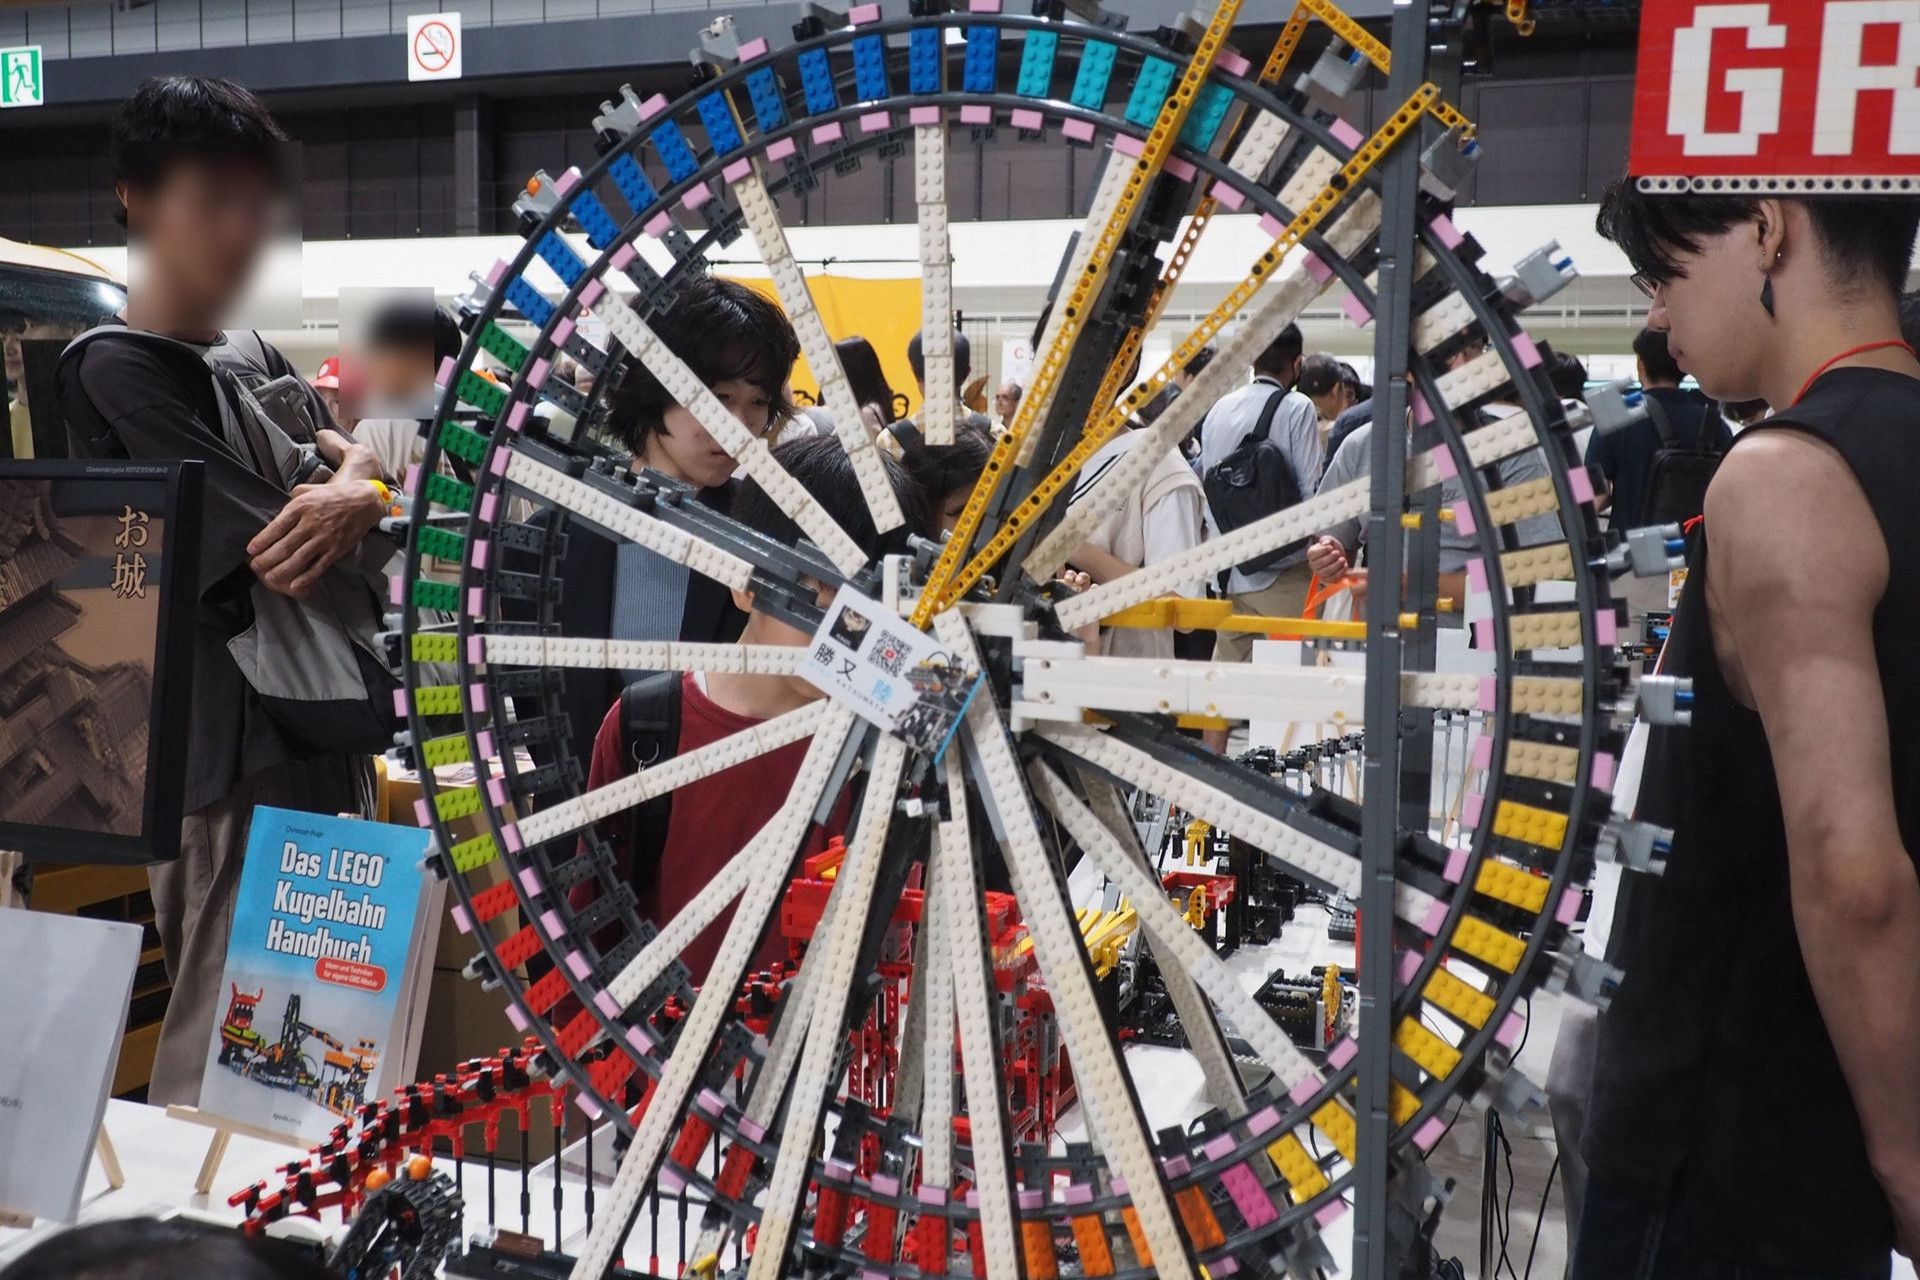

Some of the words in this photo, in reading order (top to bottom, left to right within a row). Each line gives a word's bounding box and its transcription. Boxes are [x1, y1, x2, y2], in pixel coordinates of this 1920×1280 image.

[110, 504, 151, 600] お城
[280, 841, 321, 876] Das
[273, 879, 386, 929] Kugelbahn
[265, 918, 372, 962] Handbuch
